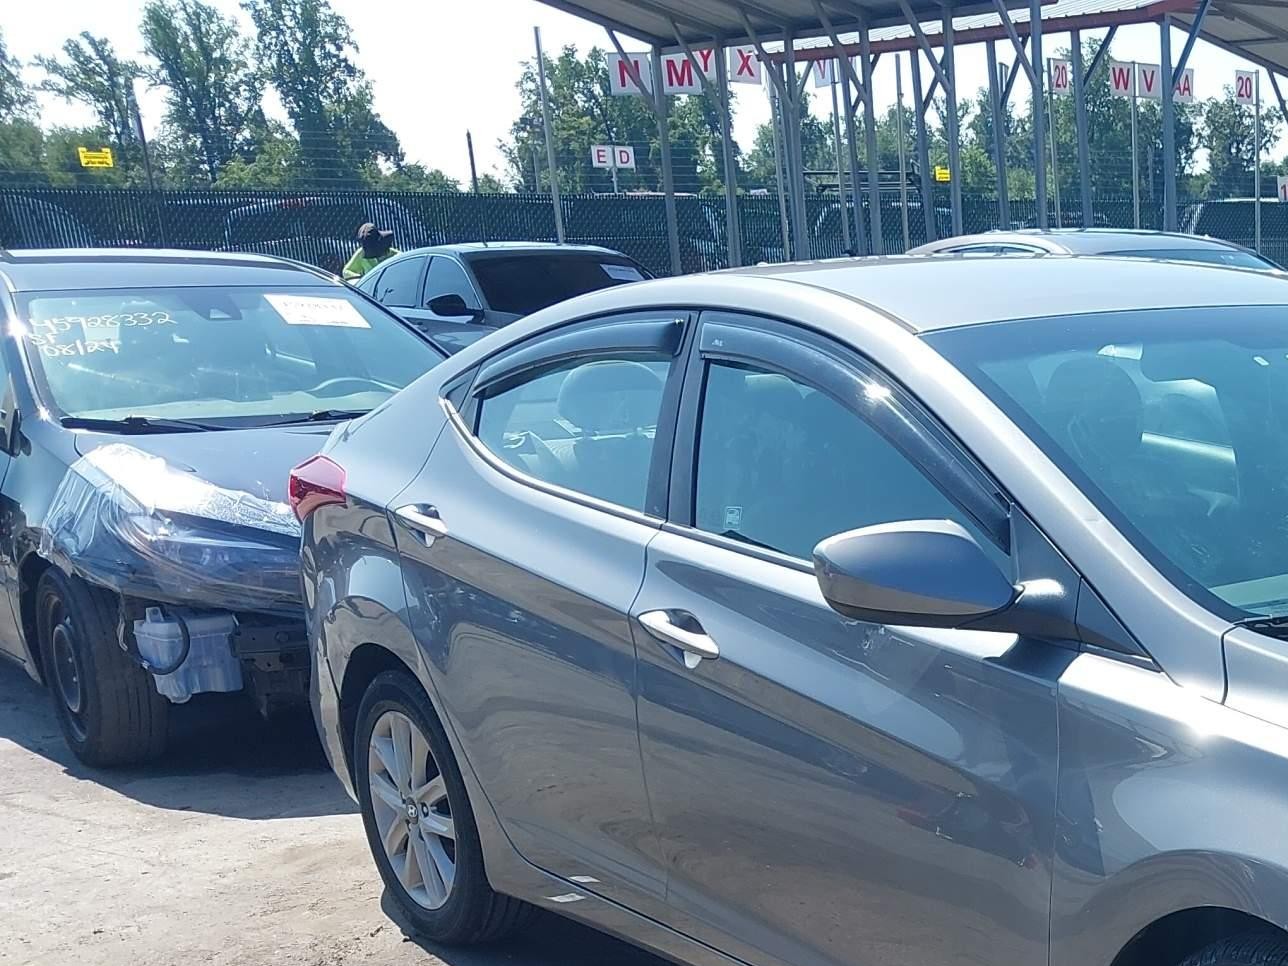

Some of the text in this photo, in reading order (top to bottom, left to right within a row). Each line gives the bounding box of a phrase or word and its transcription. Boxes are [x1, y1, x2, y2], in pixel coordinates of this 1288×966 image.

[698, 49, 713, 72] Y
[737, 49, 755, 77] X
[618, 60, 640, 88] N
[666, 59, 693, 87] M
[1054, 65, 1068, 89] 20
[1111, 67, 1130, 91] W
[1142, 69, 1155, 92] V
[1236, 76, 1252, 99] 20
[596, 149, 630, 165] E D
